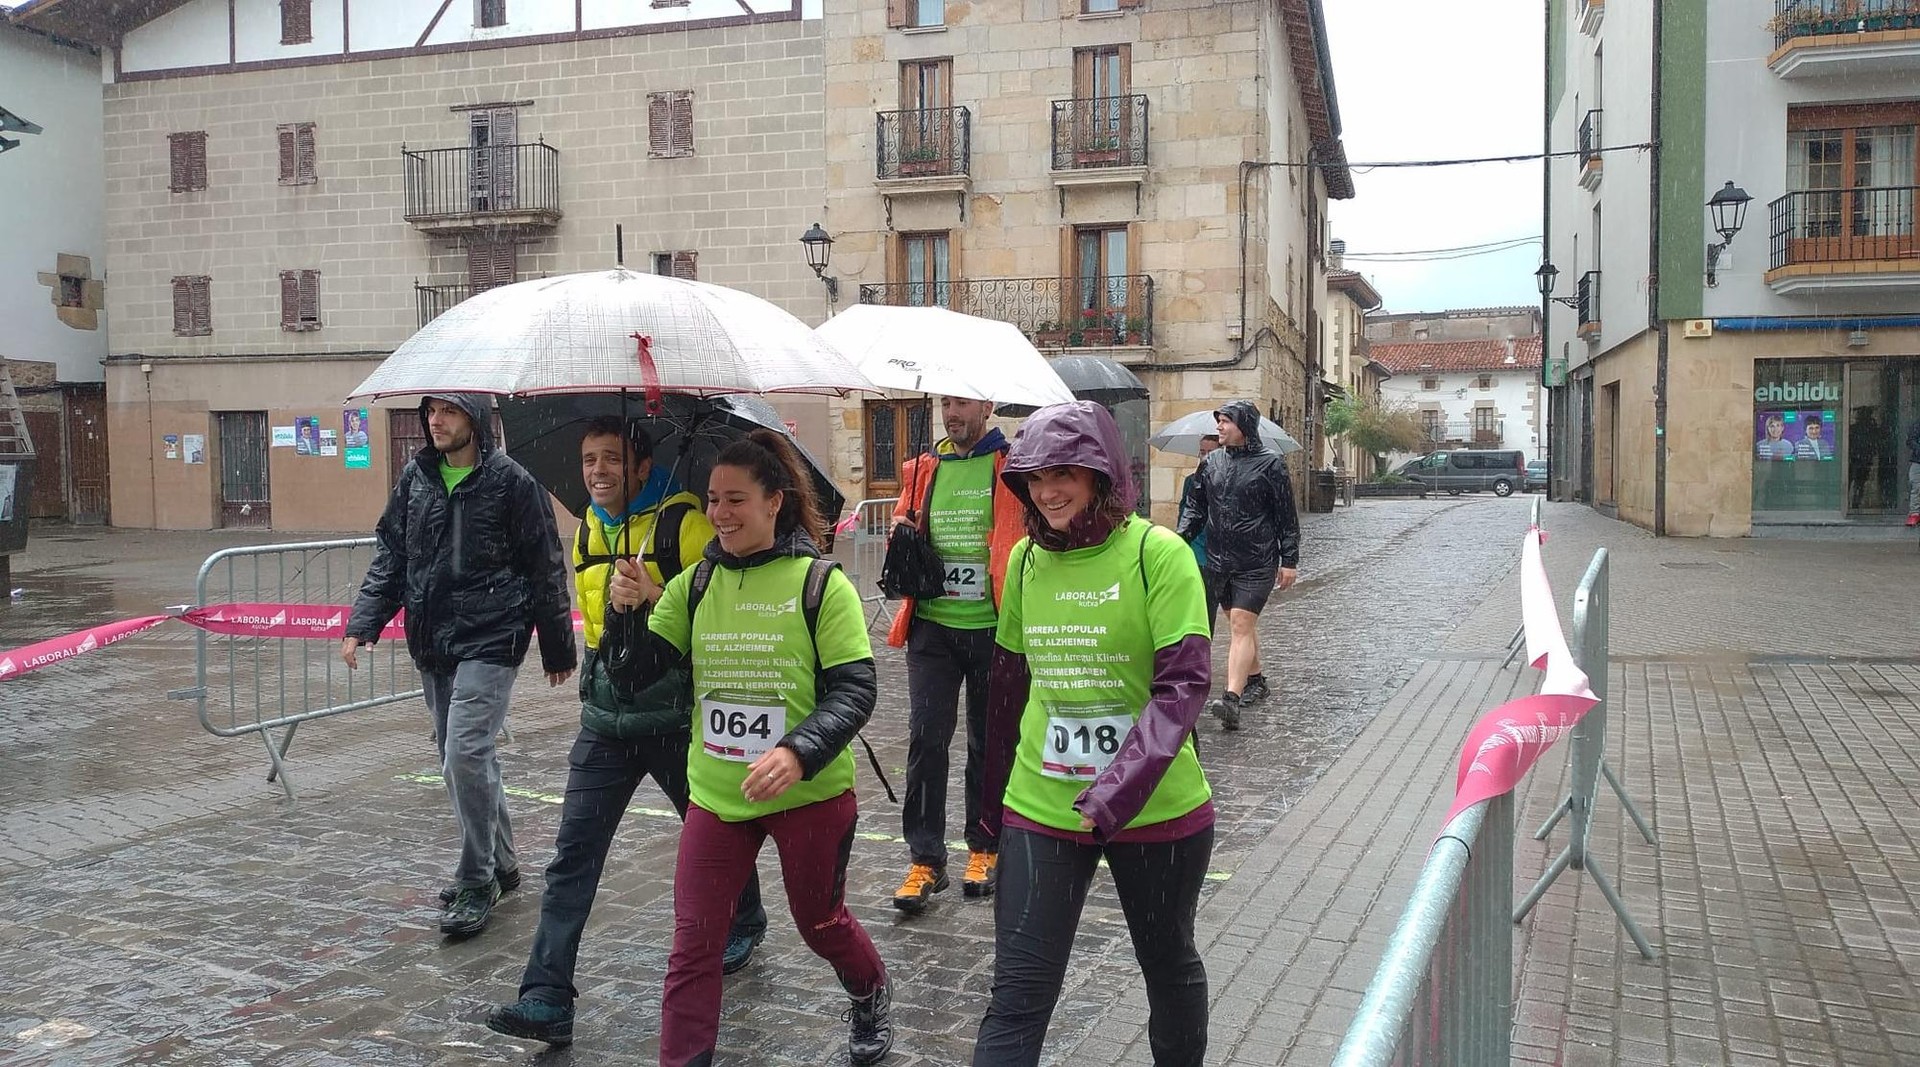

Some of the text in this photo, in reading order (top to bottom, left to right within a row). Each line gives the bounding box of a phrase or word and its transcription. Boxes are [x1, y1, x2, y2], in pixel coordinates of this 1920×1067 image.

[1755, 381, 1839, 401] ehbildu
[1055, 592, 1098, 601] LABORAL
[735, 603, 777, 612] LABORAL
[230, 616, 269, 626] LABORAL
[291, 617, 327, 627] LABORAL
[1025, 625, 1107, 635] CARRERA POPULAR
[700, 632, 784, 642] CARRERA POPULAR
[1029, 637, 1098, 647] DEL ALZHEIMER
[705, 644, 775, 653] DEL ALZHEIMER
[23, 646, 77, 668] LABORAL
[1063, 652, 1094, 663] Arregui
[1096, 652, 1130, 663] Klinika
[746, 682, 798, 690] HERRIKOIA
[710, 708, 772, 740] 064
[1053, 724, 1120, 755] 018
